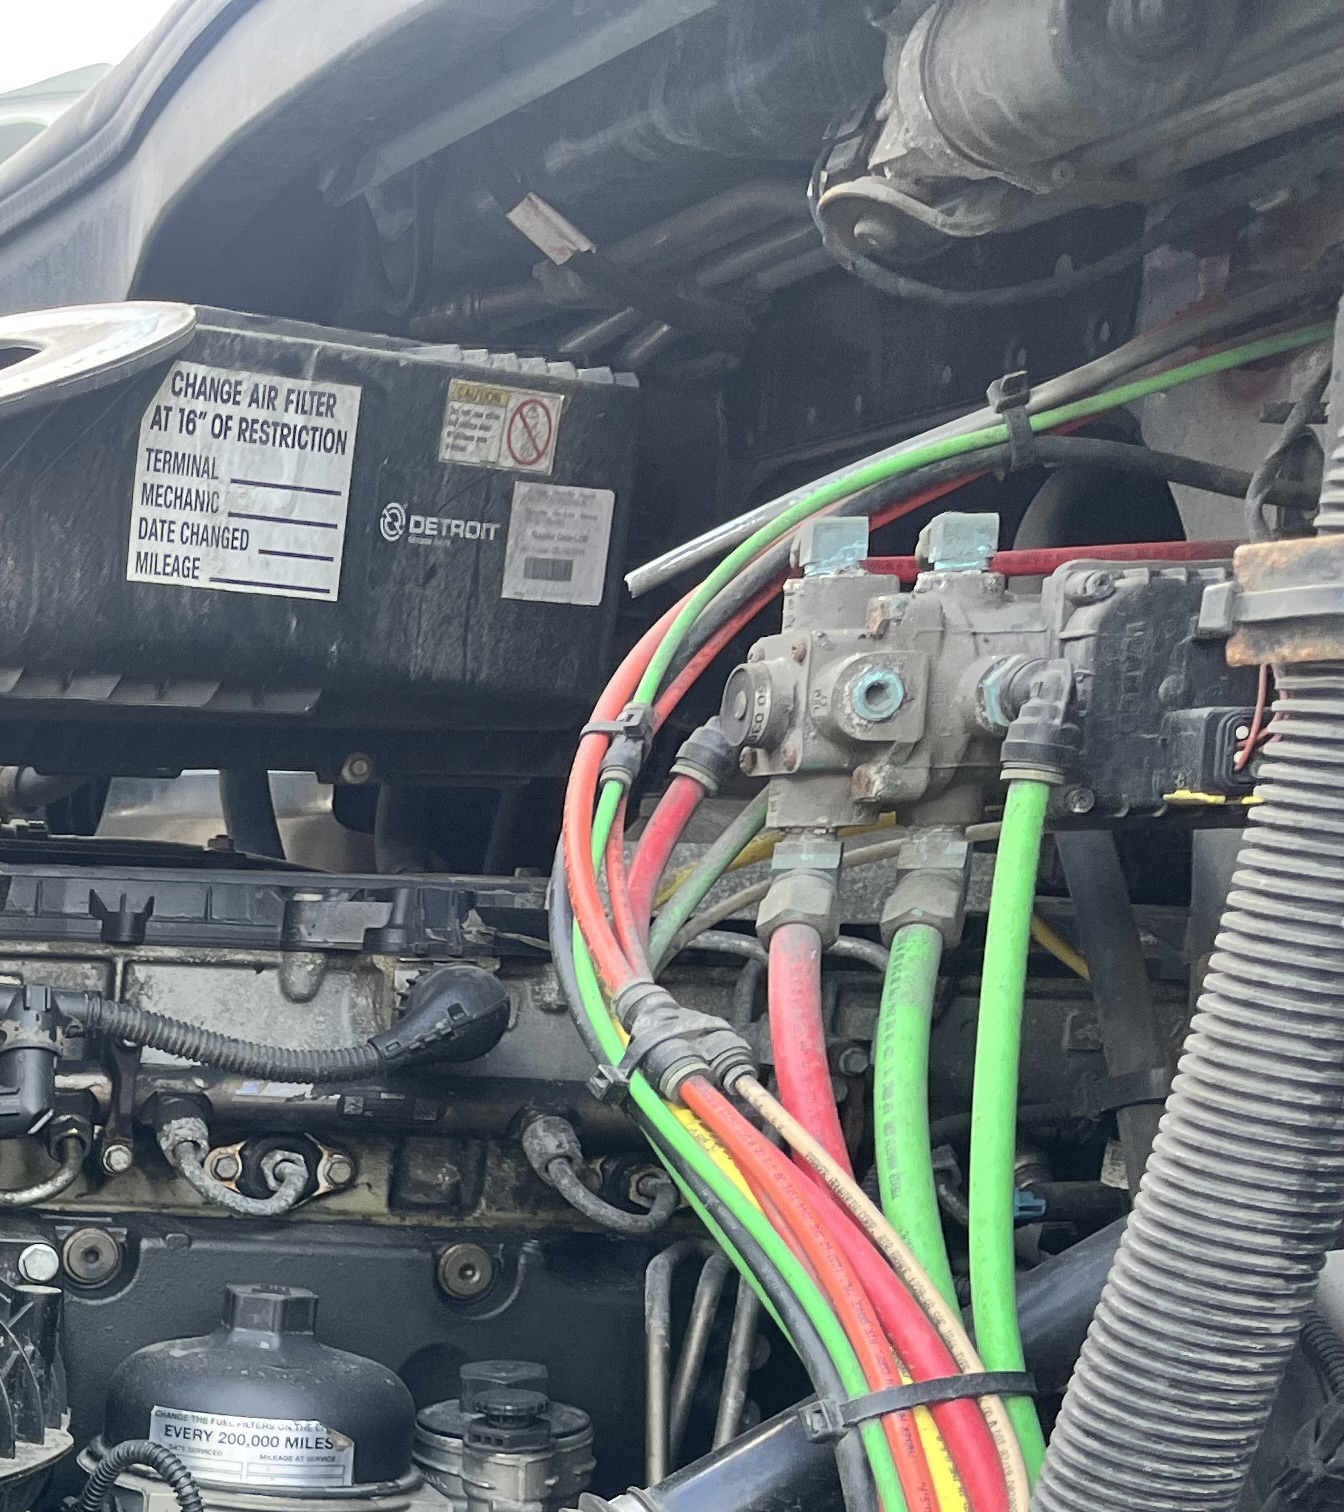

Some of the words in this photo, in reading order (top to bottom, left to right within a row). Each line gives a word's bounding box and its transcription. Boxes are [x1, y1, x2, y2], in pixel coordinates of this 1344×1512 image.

[170, 369, 243, 407] CHANGE
[247, 382, 278, 413] AIR
[284, 388, 337, 420] FILTER
[149, 405, 175, 432] AT
[177, 409, 208, 437] 16"
[210, 415, 233, 439] OF
[237, 420, 348, 456] RESTRICTION
[144, 448, 219, 481] TERMINAL
[140, 483, 220, 515] MECHANIC
[137, 517, 176, 546] DATE
[179, 521, 249, 552] CHANGED
[408, 514, 502, 542] DETROIT
[134, 551, 201, 580] MILEAGE
[154, 1410, 189, 1422] CHANGE
[190, 1414, 208, 1425] THE
[211, 1417, 235, 1428] FUEL
[237, 1421, 275, 1431] FILTERS
[164, 1424, 214, 1442] EVERY
[217, 1432, 280, 1449] 200,000
[284, 1436, 334, 1450] MILES
[187, 1445, 223, 1457] SERVICED
[259, 1453, 294, 1463] MILEAGE
